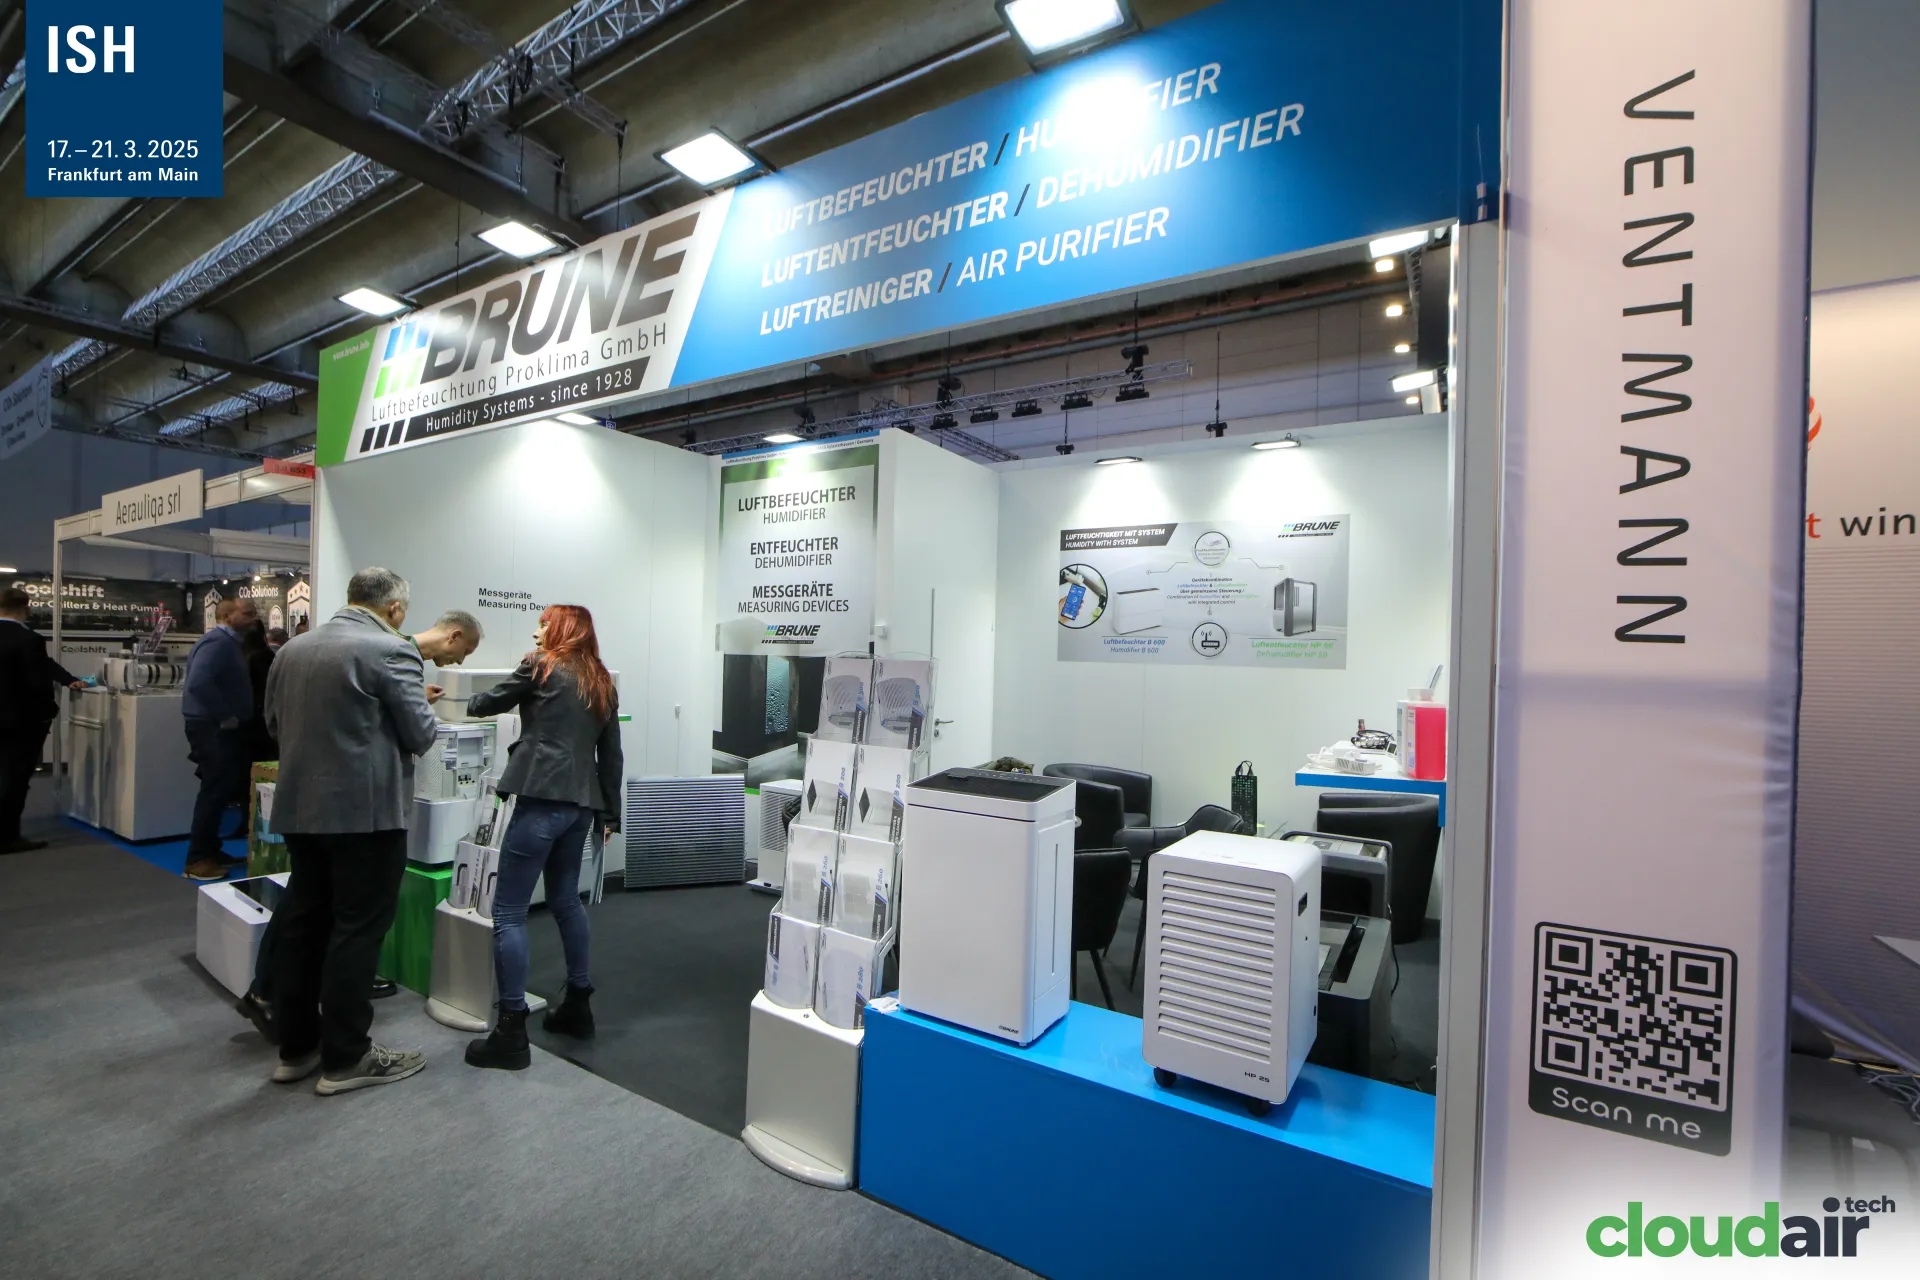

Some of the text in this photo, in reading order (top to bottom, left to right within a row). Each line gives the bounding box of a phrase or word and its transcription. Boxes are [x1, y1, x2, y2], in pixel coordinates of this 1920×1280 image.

[763, 140, 989, 239] LUFTBEFEUCHTER
[1015, 62, 1222, 157] HUFIER
[760, 191, 1009, 288] LUFTENTFEUCHTER
[1036, 103, 1305, 209] DEHUMIDIFIER
[759, 268, 934, 336] LUFTREINIGER
[956, 248, 1008, 287] AIR
[1015, 206, 1171, 273] PURIFIER
[420, 211, 701, 386] BRUNE
[1614, 68, 1697, 645] VENTMANN
[371, 322, 666, 422] Luftbefeuchtung Proklima GmbH
[426, 408, 479, 432] Humidity
[483, 395, 535, 420] Systems
[550, 382, 588, 403] since
[595, 368, 632, 392] 1928
[116, 485, 181, 526] Aerauliqa srl
[738, 485, 856, 512] LUFTBEFEUCHTER
[763, 507, 826, 525] HUMIDIFIER
[1065, 530, 1124, 541] LUFTFEUCHTIGKEIT
[1137, 528, 1166, 536] SYSTEM
[1293, 521, 1341, 531] BRUNE
[750, 536, 839, 556] ENTFEUCHTER
[1065, 538, 1139, 549] HUMIDITY WITH SYSTEM
[755, 553, 833, 569] DEHUMIDIFIER
[251, 585, 279, 598] Solutions
[478, 587, 532, 600] Messgeräte
[752, 580, 834, 599] MESSGERÄTE
[28, 599, 45, 608] for
[92, 602, 101, 610] &
[103, 602, 128, 611] Heat
[478, 599, 527, 612] Measuring
[737, 599, 850, 614] MEASURING DEVICES
[775, 624, 821, 636] BRUNE
[1551, 1086, 1702, 1139] Scan me
